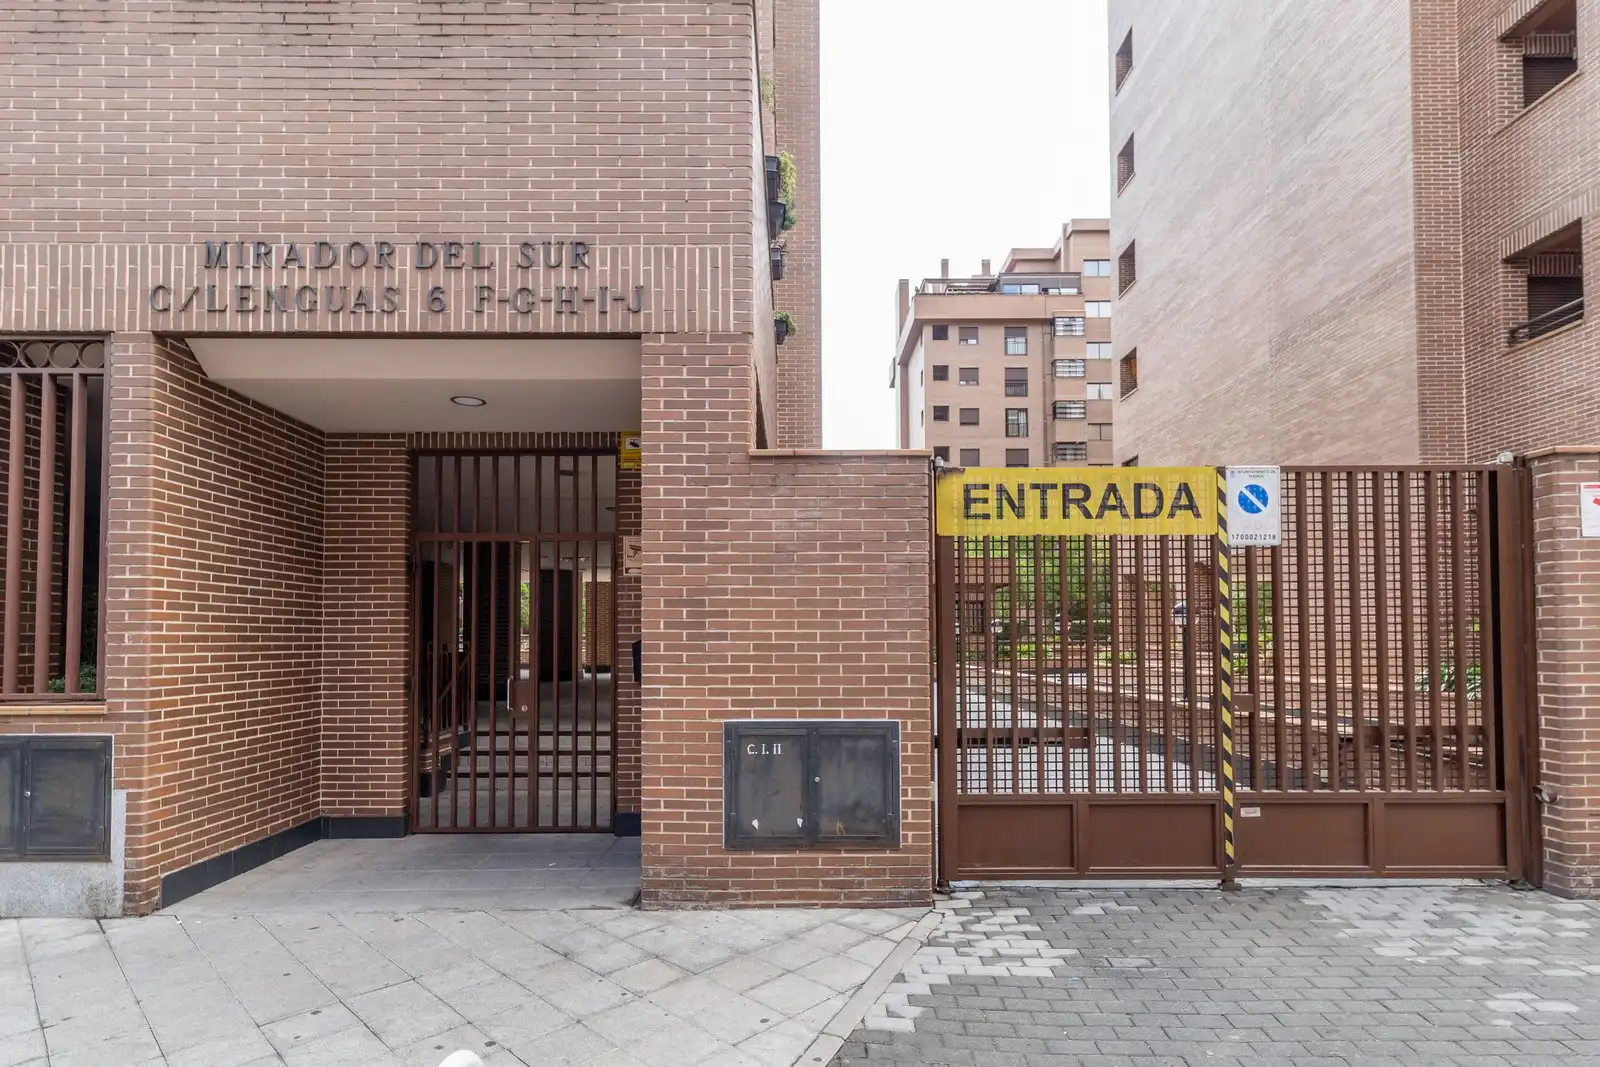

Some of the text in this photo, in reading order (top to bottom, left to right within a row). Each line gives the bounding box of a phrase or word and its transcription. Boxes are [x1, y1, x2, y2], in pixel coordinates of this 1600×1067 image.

[204, 240, 591, 269] MIRADOR DEL SUR
[149, 284, 645, 314] C/LENGUAS 6 F-G-H-I-J
[963, 482, 1203, 521] ENTRADA
